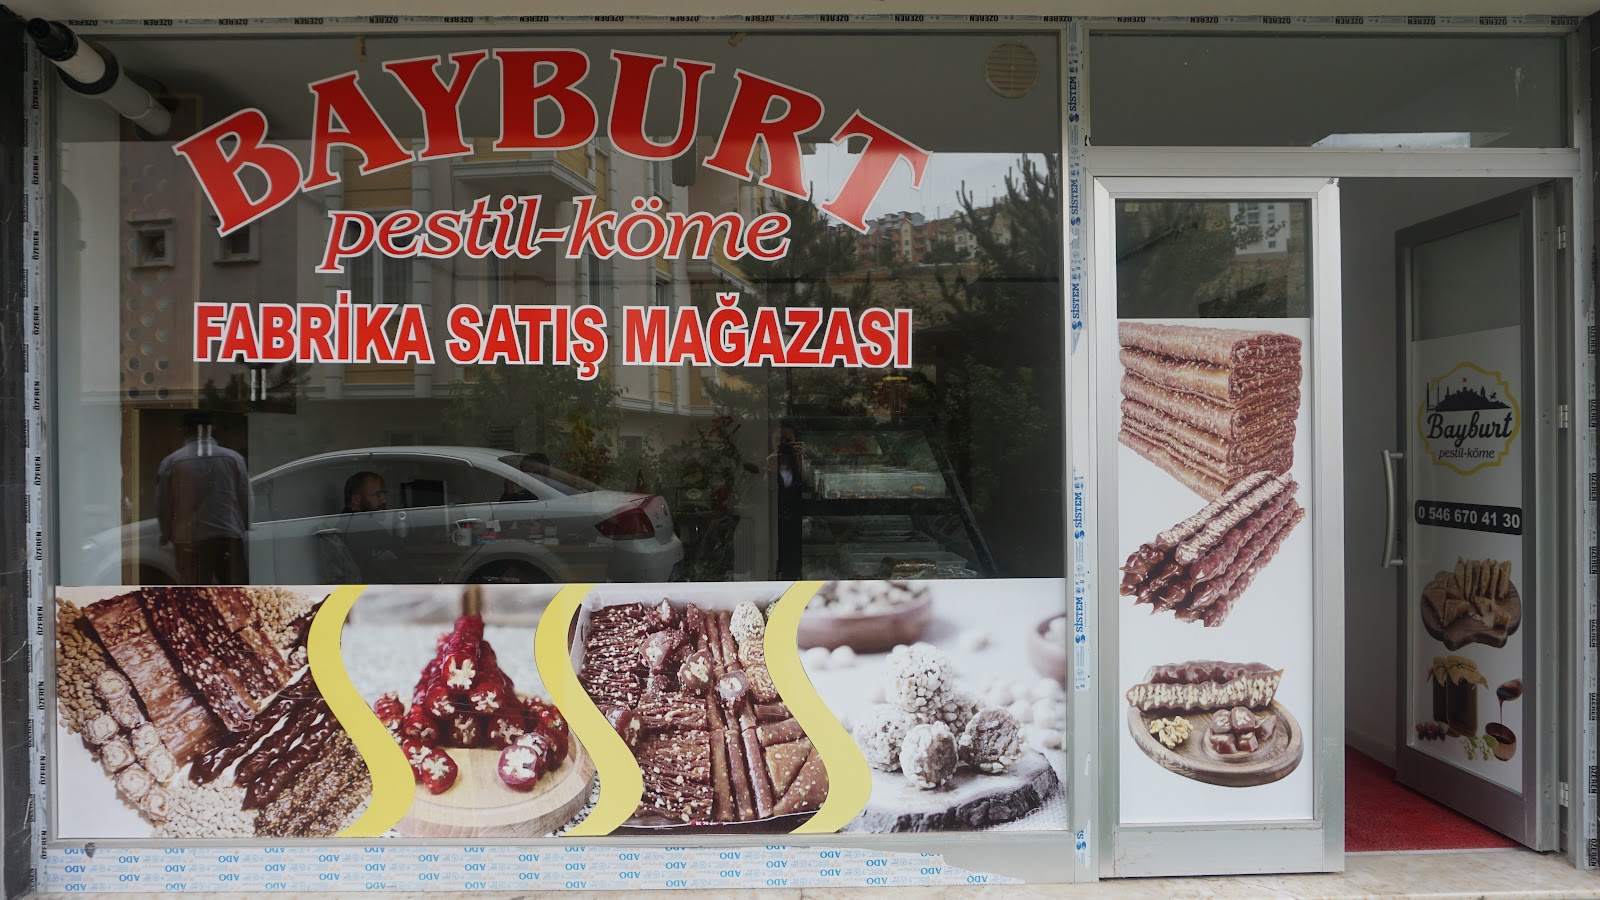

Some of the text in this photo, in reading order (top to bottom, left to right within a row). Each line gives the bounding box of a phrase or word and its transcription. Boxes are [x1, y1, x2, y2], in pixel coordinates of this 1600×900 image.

[1069, 76, 1077, 112] SİSTEM
[172, 47, 932, 236] BAYBURT
[1070, 179, 1079, 215] SİSTEM
[315, 194, 791, 274] pestil-köme
[1070, 283, 1080, 319] SİSTEM
[193, 290, 912, 380] FABRİKA SATIŞ MAĞAZASI
[1427, 411, 1512, 447] Bayburt
[1438, 448, 1495, 460] pestil-köme
[1073, 492, 1083, 528] SİSTEM
[1418, 506, 1520, 528] 0 546 670 41 30
[1074, 597, 1083, 633] SİSTEM
[65, 859, 887, 873] ADO ADO ADO ADO ADO ADO ADO ADO ADO
[118, 851, 840, 864] ADO ADO ADO ADO ADO ADO ADO ADO
[119, 867, 942, 882] ADO ADO ADO ADO ADO ADO ADO ADO ADO
[65, 884, 86, 892] ADO
[166, 883, 187, 891] ADO
[266, 882, 287, 890] ADO
[465, 881, 486, 889] ADO
[566, 881, 587, 889] ADO
[666, 879, 687, 887] ADO
[765, 878, 787, 886] ADO
[866, 877, 887, 885] ADO
[967, 876, 988, 884] ADO
